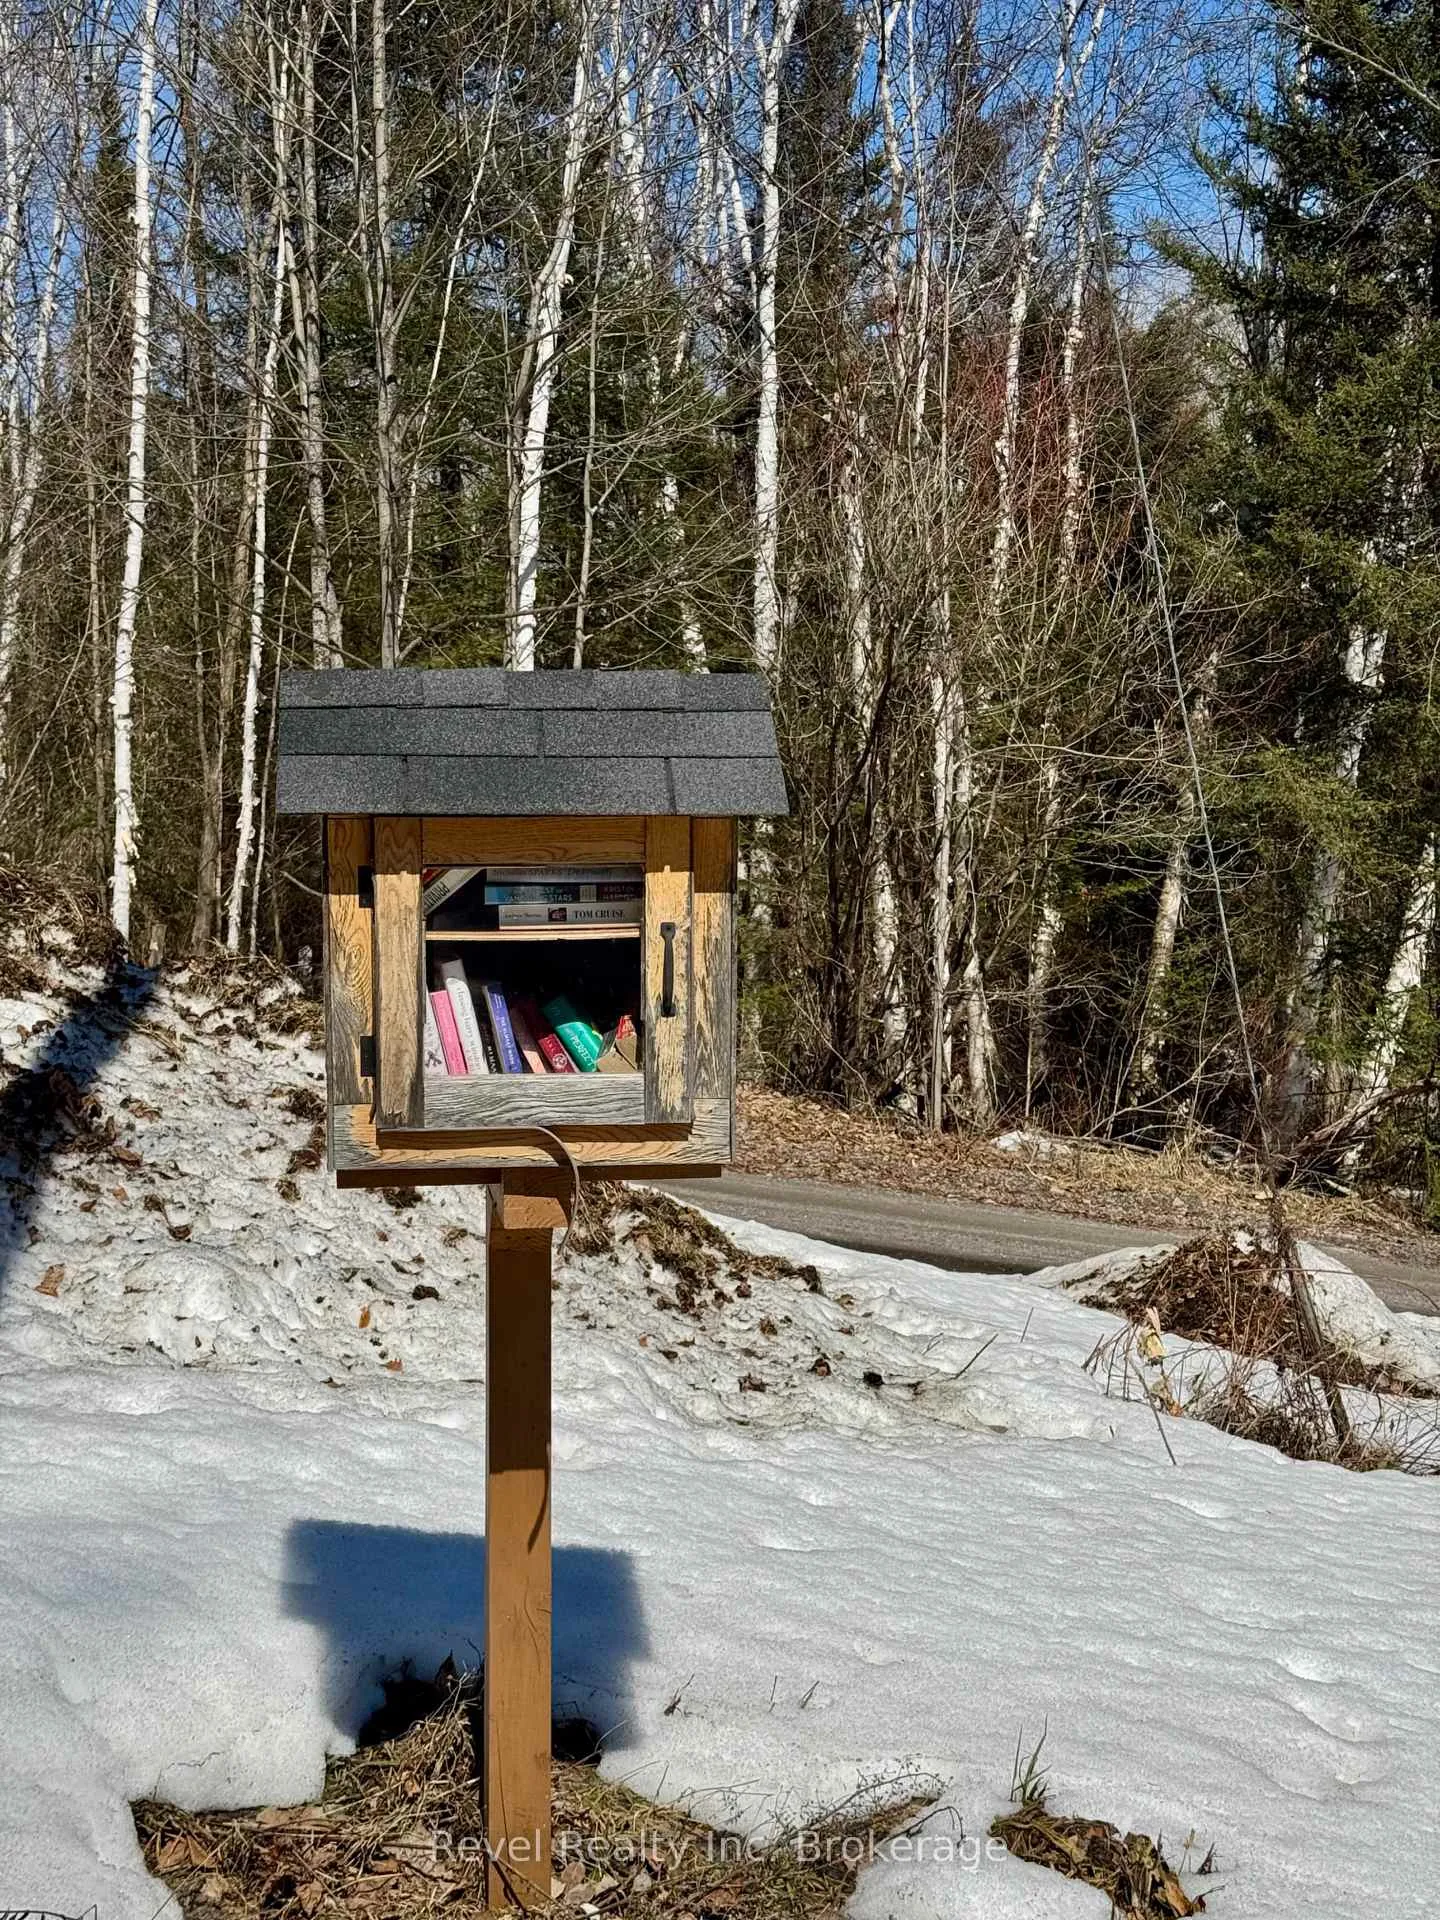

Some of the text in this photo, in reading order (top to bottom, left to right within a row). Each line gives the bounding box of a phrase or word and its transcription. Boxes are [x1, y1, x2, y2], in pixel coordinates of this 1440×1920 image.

[575, 909, 625, 919] TOM CRUISE
[569, 1034, 596, 1067] PERFECT
